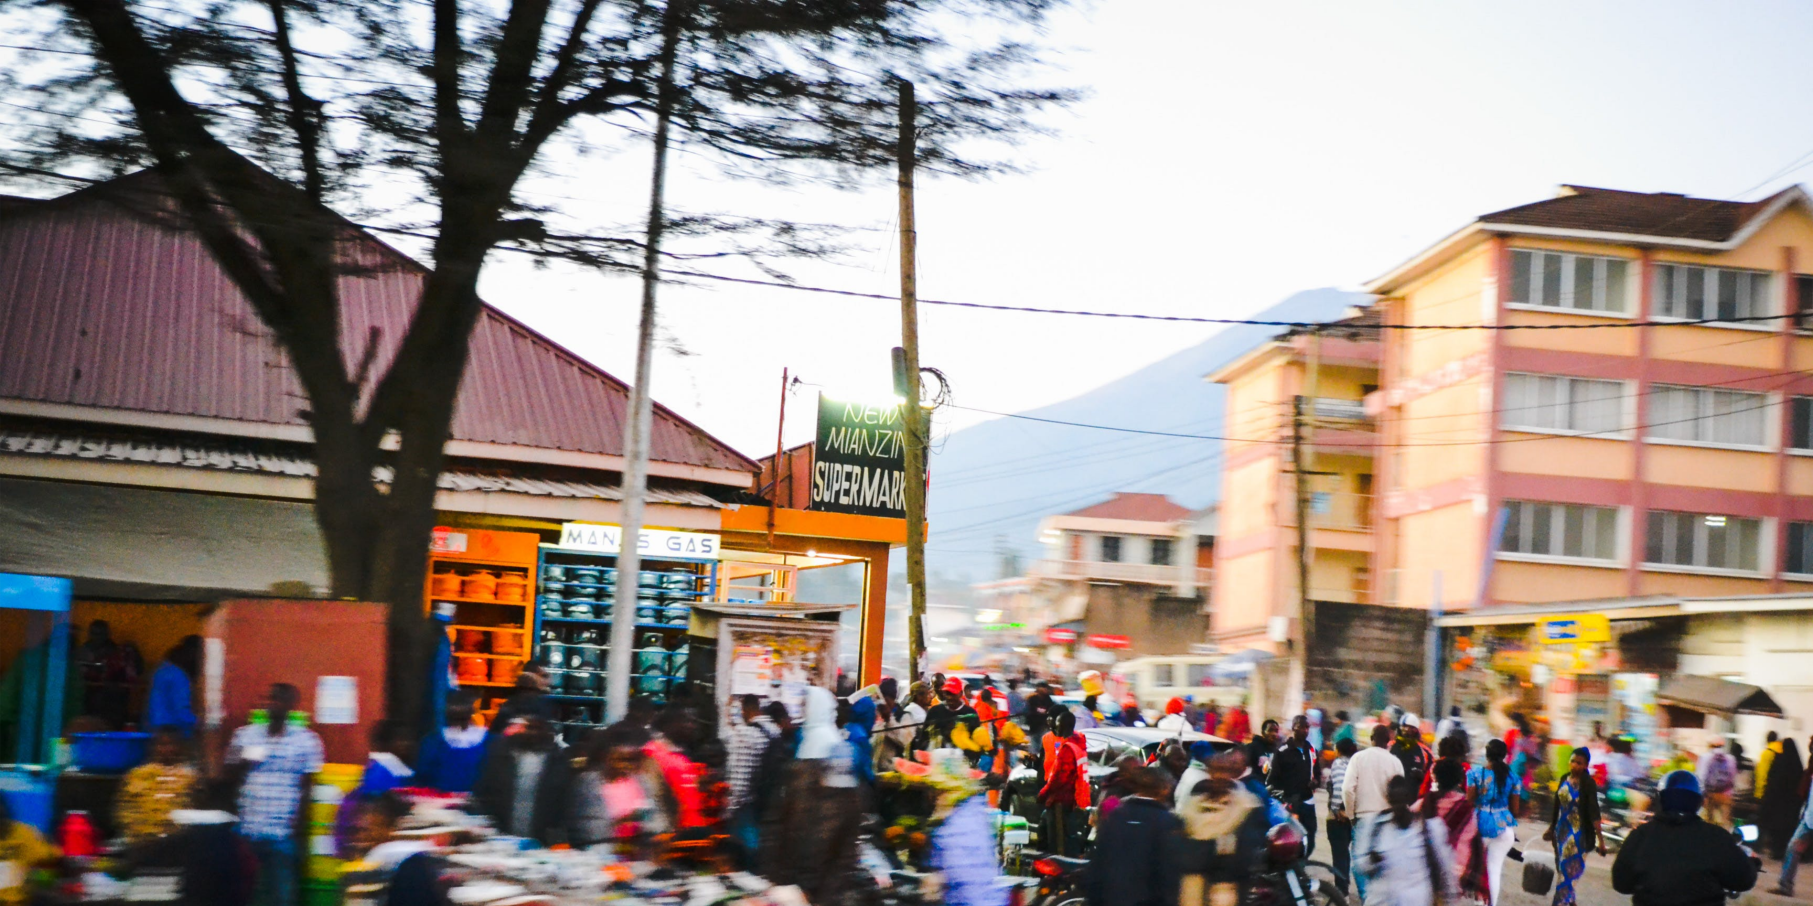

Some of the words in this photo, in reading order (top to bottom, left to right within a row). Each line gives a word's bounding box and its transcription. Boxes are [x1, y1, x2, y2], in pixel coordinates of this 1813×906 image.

[843, 402, 899, 425] NEW
[825, 426, 905, 459] MIANZIN
[813, 460, 925, 512] SUPERMARK
[666, 536, 713, 554] GAS
